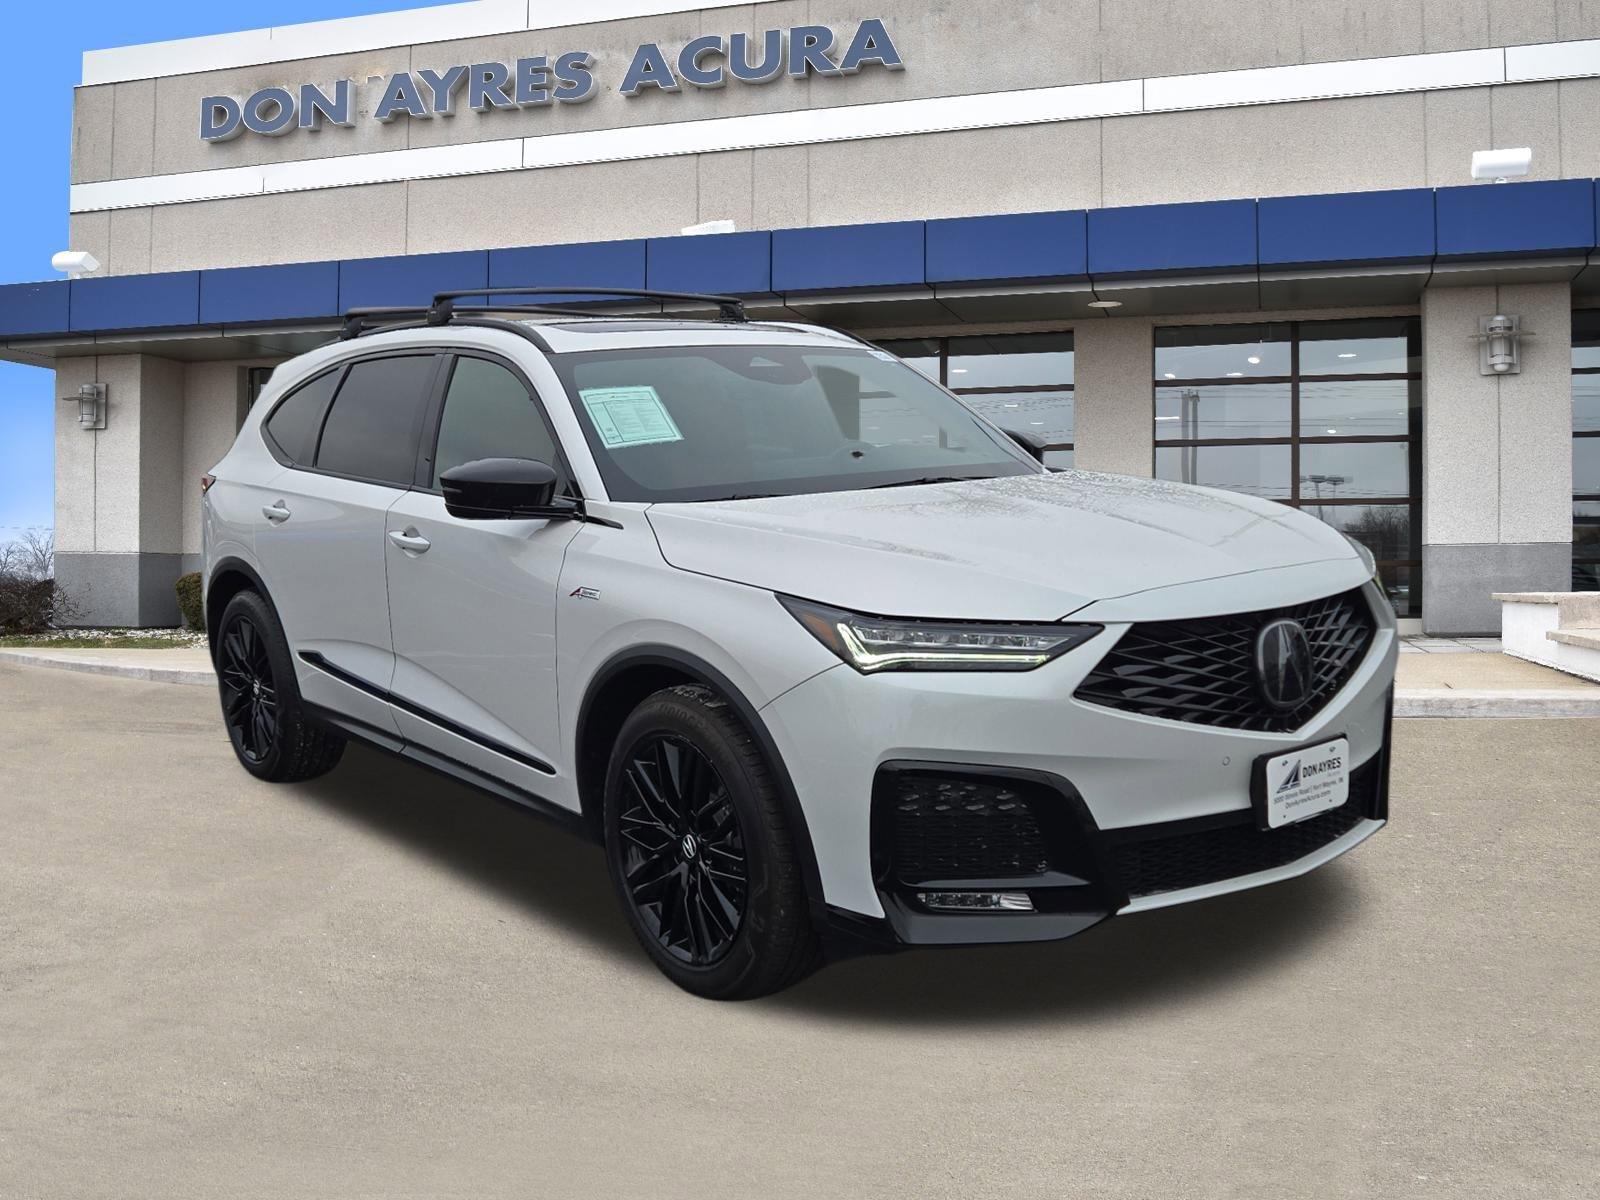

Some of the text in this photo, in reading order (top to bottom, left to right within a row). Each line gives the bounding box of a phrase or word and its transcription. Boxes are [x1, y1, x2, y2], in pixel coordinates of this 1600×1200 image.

[200, 17, 905, 142] DON AYRES ACURA
[1303, 765, 1318, 778] DON
[1318, 757, 1342, 772] AYRES
